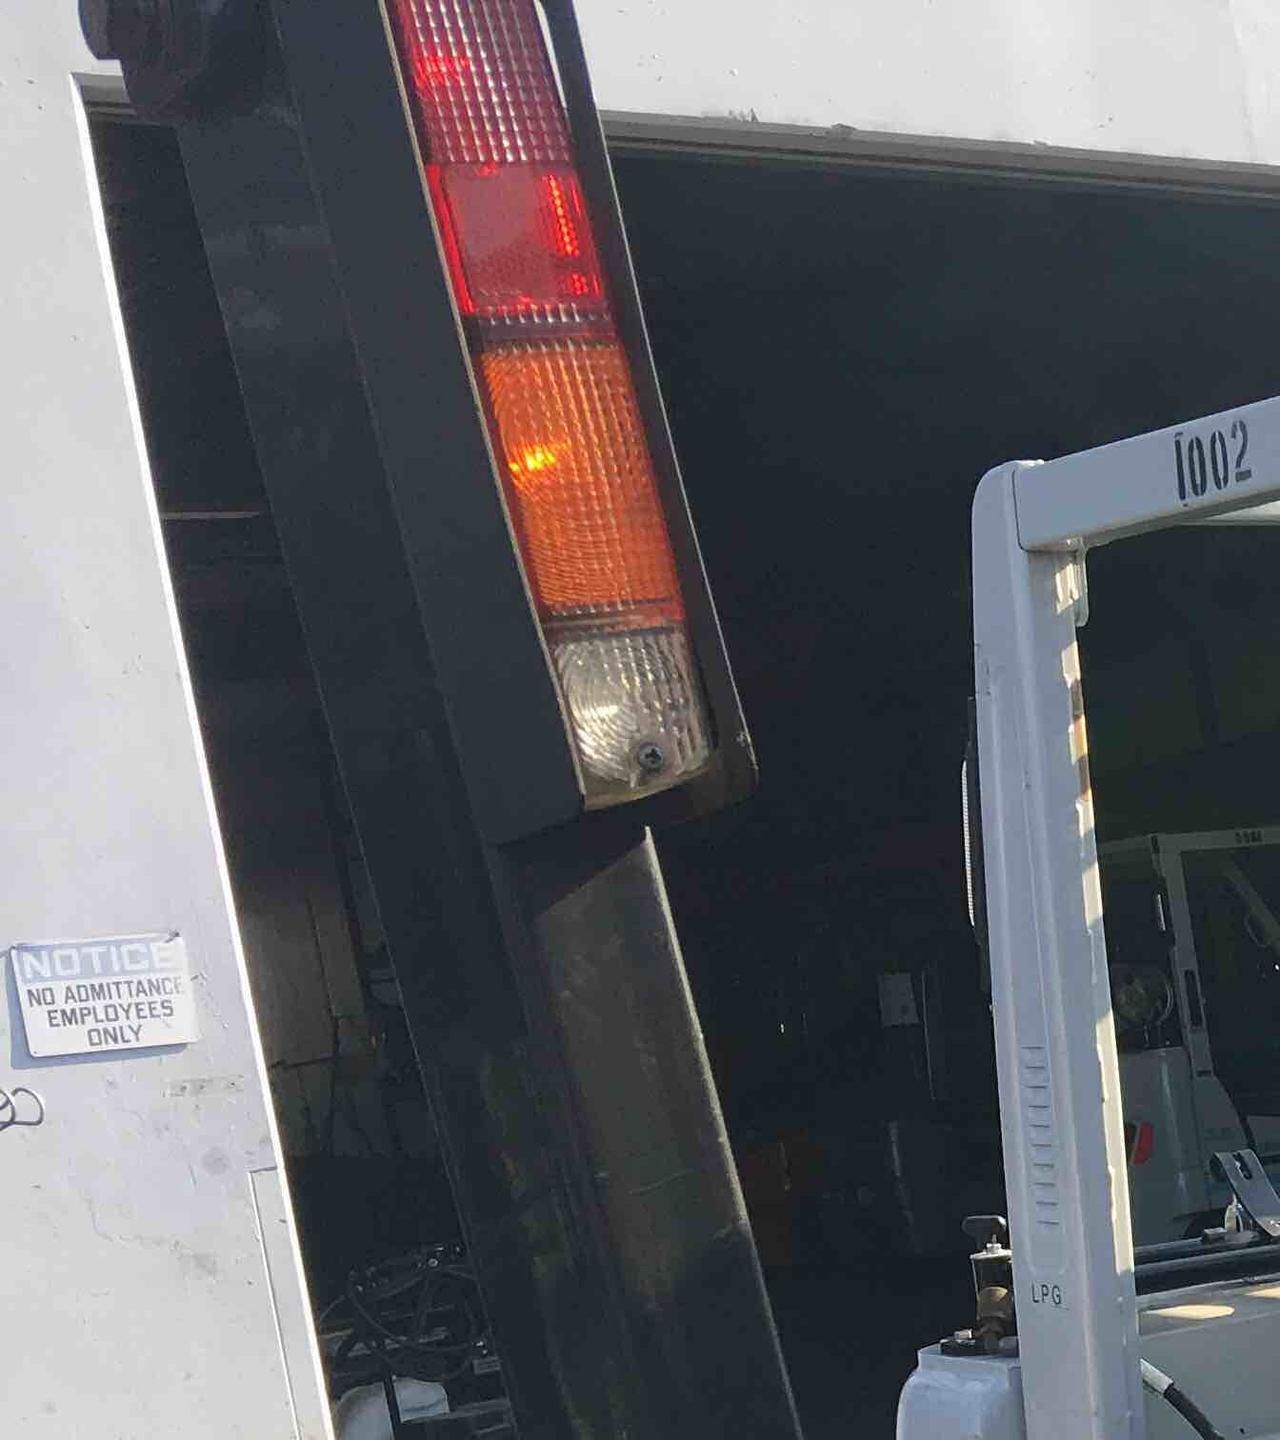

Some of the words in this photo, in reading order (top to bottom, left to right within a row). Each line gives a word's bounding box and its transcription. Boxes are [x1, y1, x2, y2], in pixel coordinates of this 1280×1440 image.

[1174, 420, 1252, 506] 1002
[22, 942, 173, 979] NOTICE
[27, 987, 56, 1007] NO
[64, 975, 185, 1005] ADMITTANCE
[47, 1000, 174, 1027] EMPLOYEES
[87, 1025, 142, 1047] ONLY
[1031, 1283, 1062, 1305] LPG
